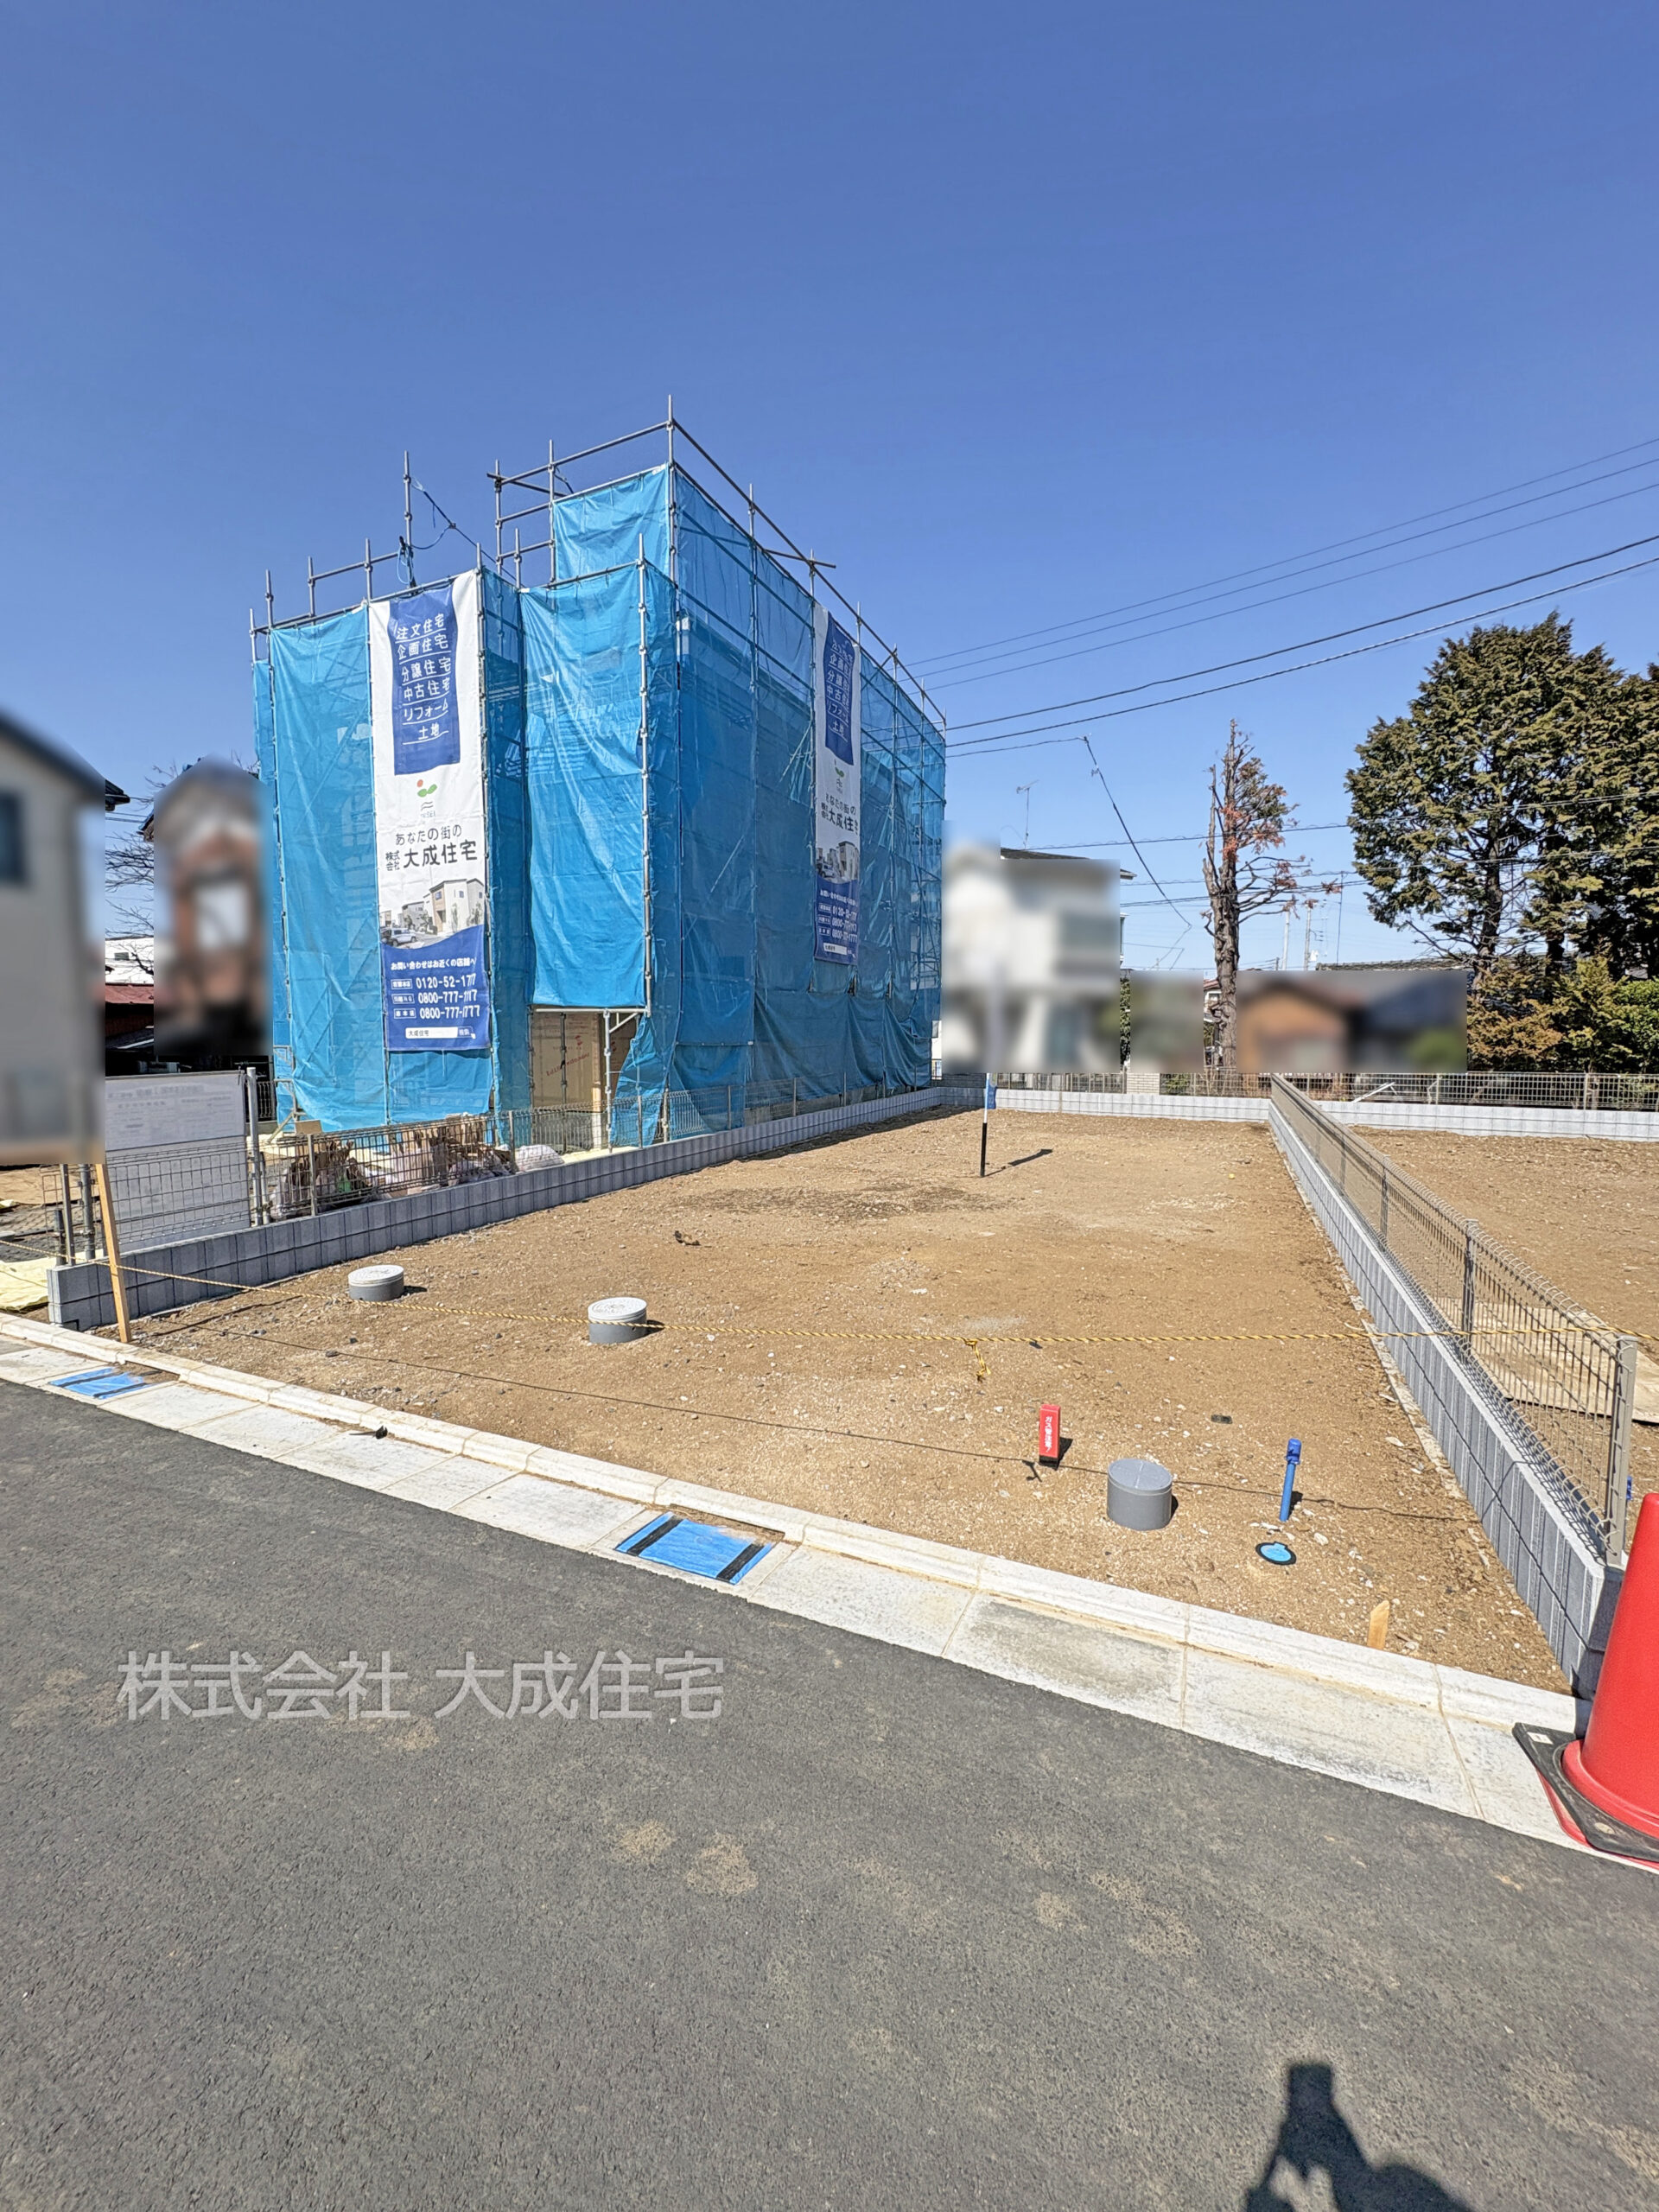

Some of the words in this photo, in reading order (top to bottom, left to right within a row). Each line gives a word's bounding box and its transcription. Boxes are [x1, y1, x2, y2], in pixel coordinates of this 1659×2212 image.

[397, 613, 445, 640] 注文住宅
[397, 633, 448, 660] 企画住宅
[401, 657, 451, 683] 分譲住宅
[404, 677, 450, 701] 中古住宅
[404, 699, 448, 720] リフォーム
[418, 722, 440, 741] 土地
[395, 824, 462, 846] あなたの街の
[404, 839, 477, 868] 大成住宅
